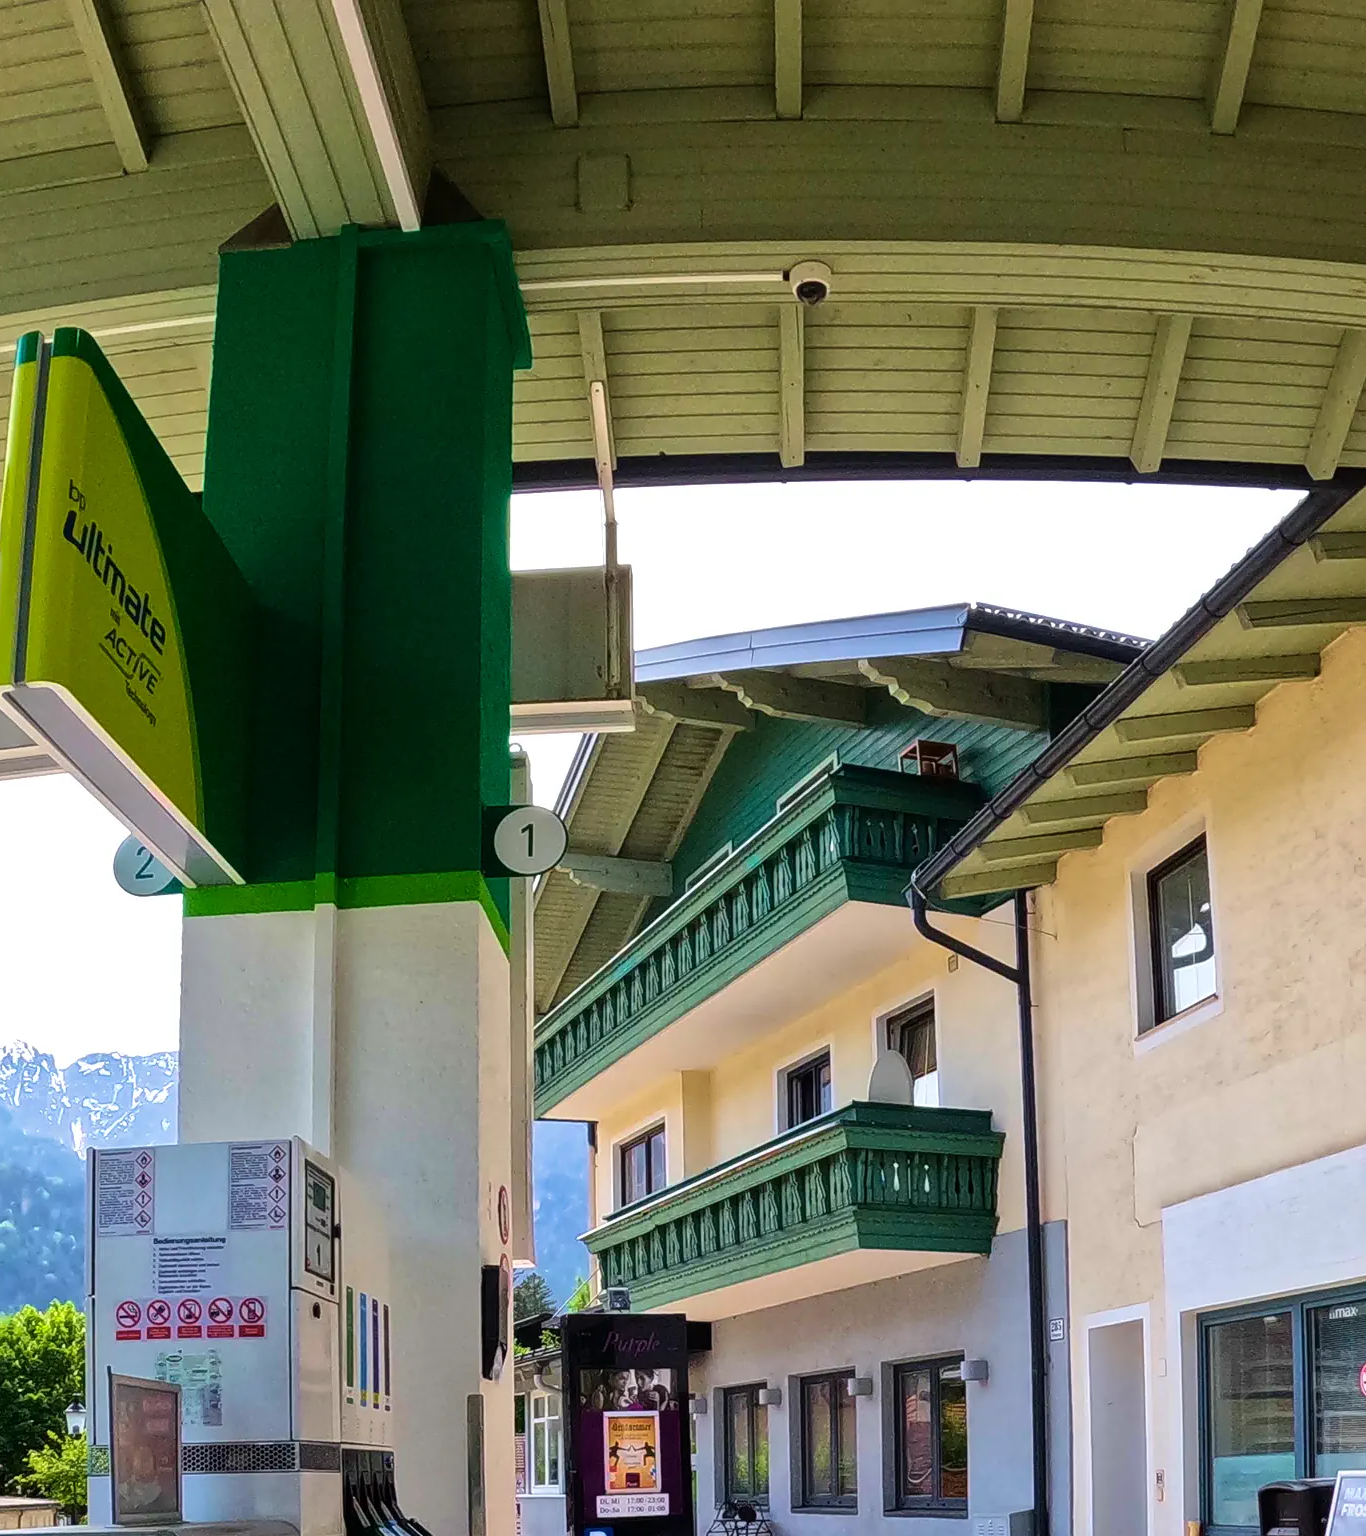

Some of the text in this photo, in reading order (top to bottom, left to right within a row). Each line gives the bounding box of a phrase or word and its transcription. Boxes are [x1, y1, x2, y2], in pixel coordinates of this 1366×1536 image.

[69, 479, 86, 511] bp
[63, 510, 166, 656] ultimate
[104, 628, 158, 694] ACTIVE
[520, 824, 535, 857] 1
[135, 846, 154, 878] 2
[603, 1331, 661, 1358] Purple
